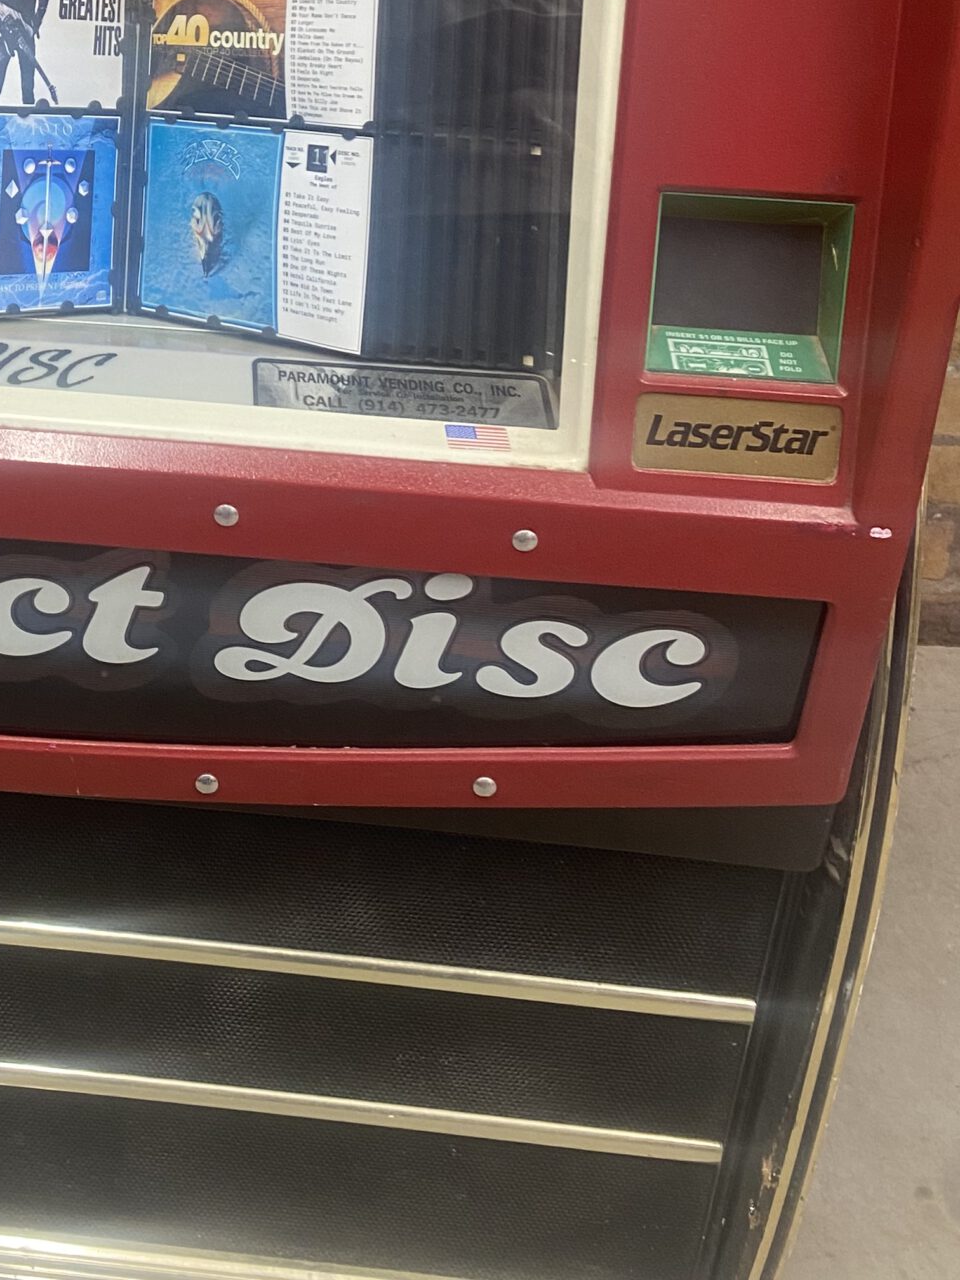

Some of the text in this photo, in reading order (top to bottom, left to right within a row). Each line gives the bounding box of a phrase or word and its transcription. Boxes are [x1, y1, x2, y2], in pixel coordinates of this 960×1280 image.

[93, 25, 122, 57] HITS
[152, 14, 285, 56] TOP 40 country
[278, 370, 370, 388] PARAMOUNT
[378, 378, 444, 393] VENDING
[491, 385, 521, 398] INC.
[303, 395, 501, 419] CALL (914) 473-2477
[646, 414, 829, 455] LaserStar
[210, 572, 713, 710] Disc
